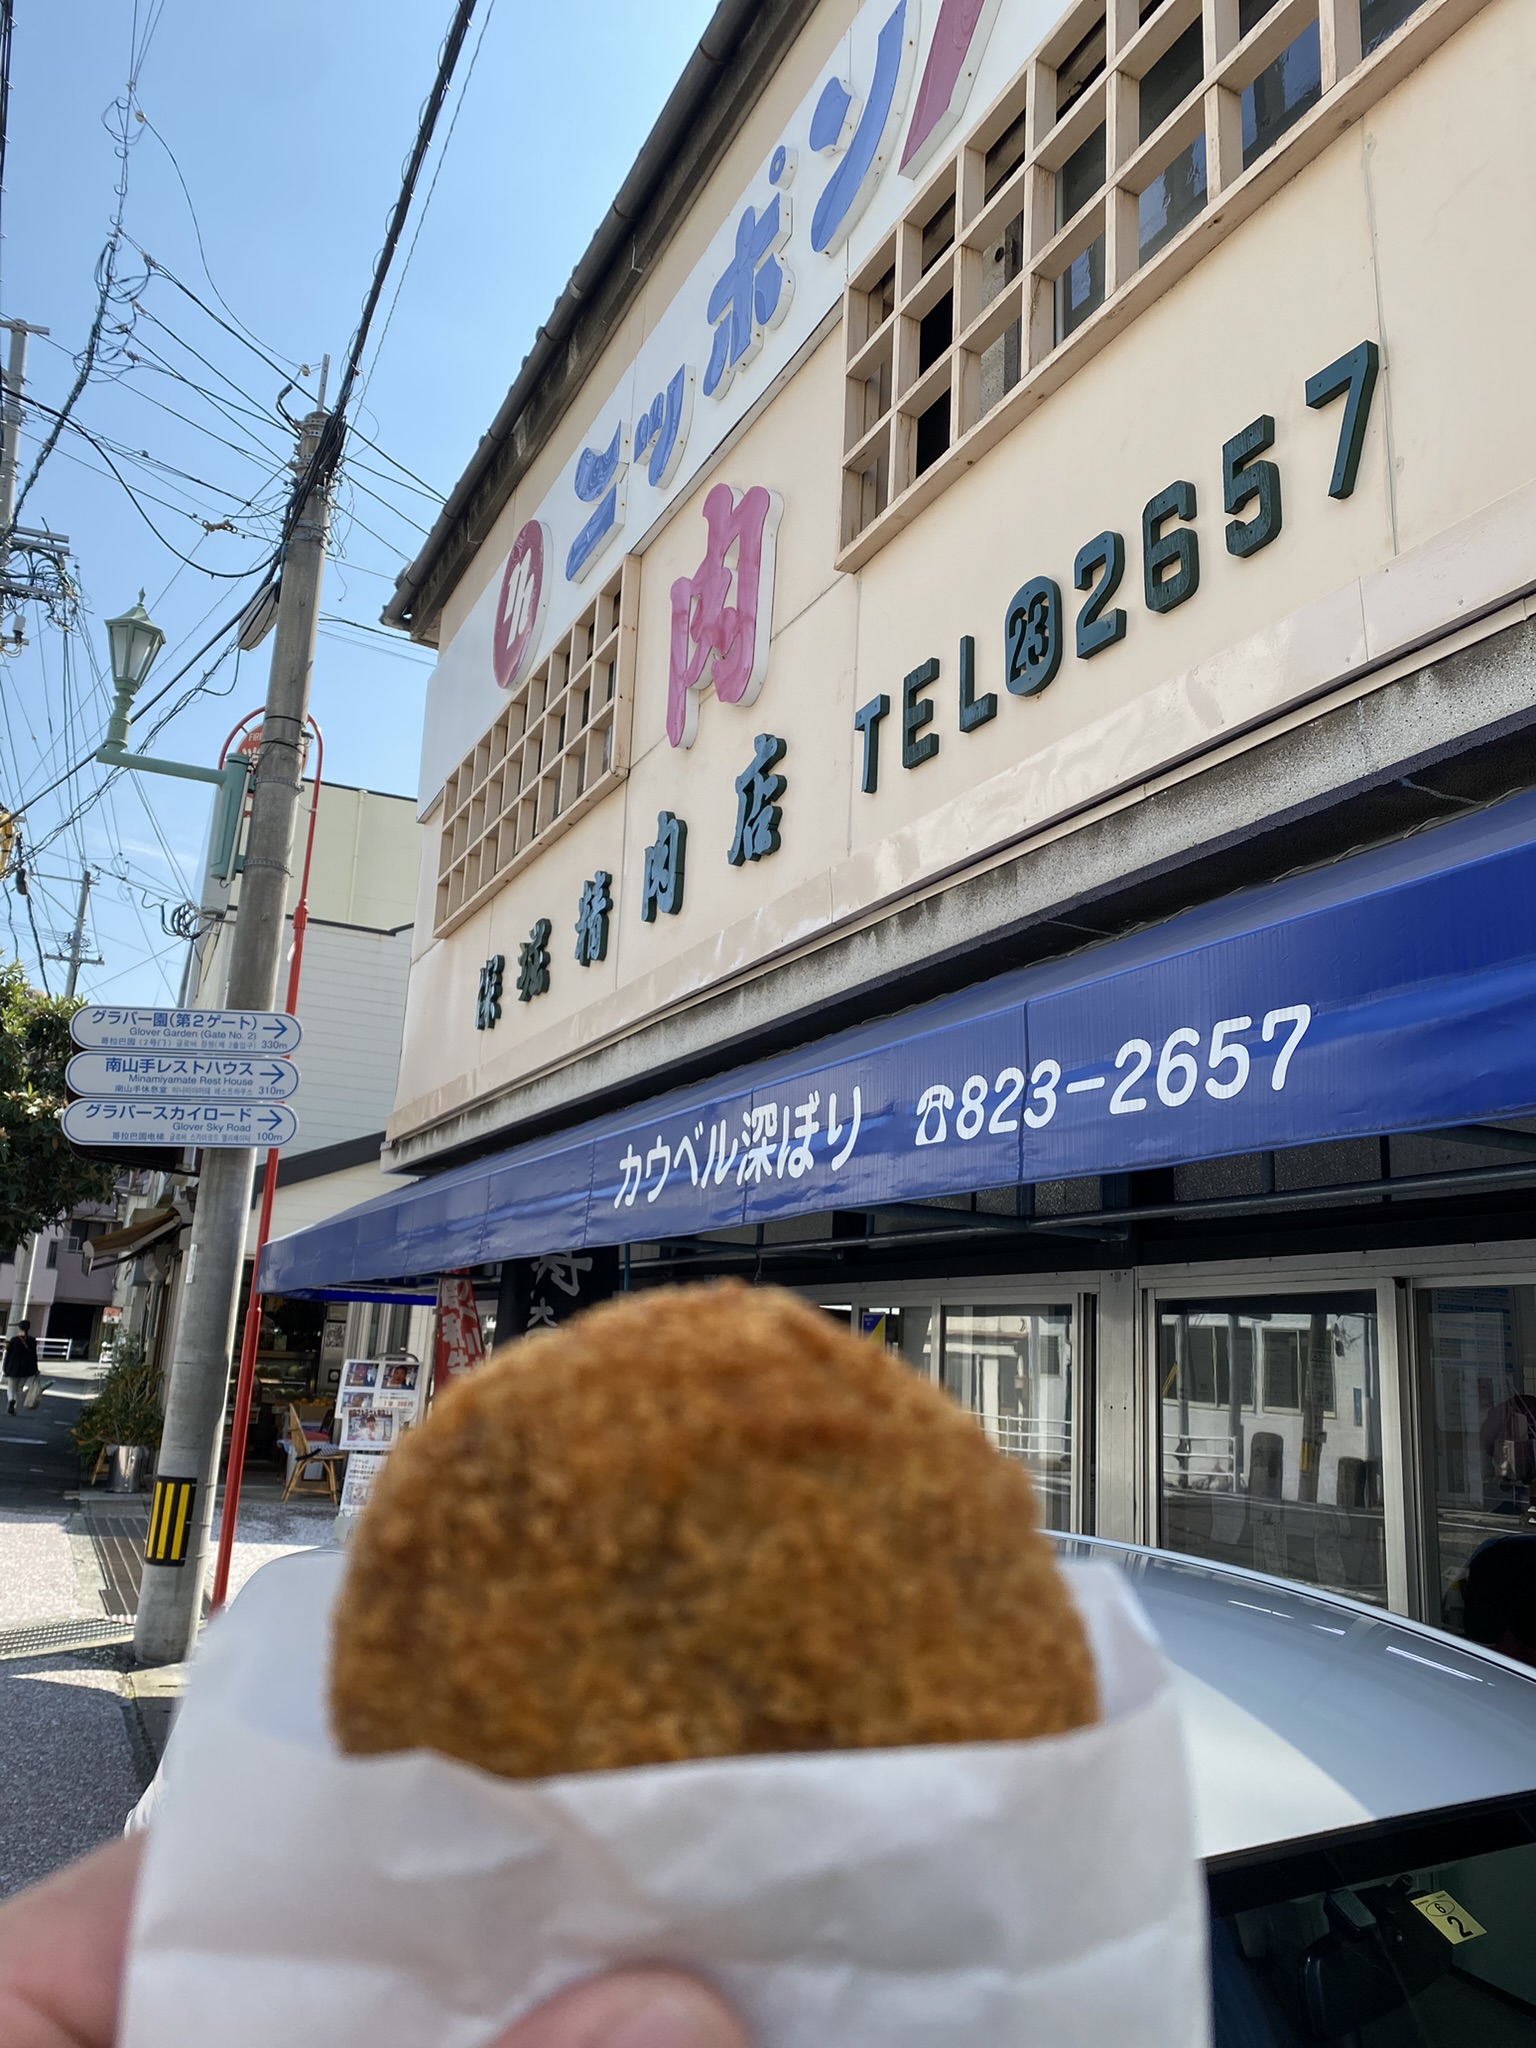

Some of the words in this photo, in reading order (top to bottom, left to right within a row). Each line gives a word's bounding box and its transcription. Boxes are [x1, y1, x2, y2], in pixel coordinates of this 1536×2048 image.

[854, 635, 998, 794] TEL
[1074, 339, 1380, 662] 2657
[666, 483, 784, 750] 肉
[92, 1009, 257, 1029] グラバー園(第2ゲート)
[129, 1027, 160, 1037] Glover
[162, 1028, 198, 1038] Garden
[200, 1030, 227, 1040] (Gate
[229, 1031, 245, 1040] No.
[247, 1032, 257, 1041] 2)
[261, 1039, 288, 1050] 330m
[105, 1057, 254, 1076] 南山手レストハウス
[956, 1003, 1312, 1141] 823-2657
[128, 1074, 197, 1086] Minamiyamate
[199, 1075, 222, 1085] Rest
[223, 1076, 254, 1086] House
[258, 1086, 285, 1096] 310m
[85, 1103, 252, 1123] グラバースカイロード
[172, 1121, 204, 1131] Glover
[205, 1122, 224, 1133] Sky
[226, 1123, 252, 1132] Road
[256, 1132, 283, 1142] 100m
[614, 1085, 861, 1208] カウベル深ぼり
[1447, 1916, 1473, 1937] 2
